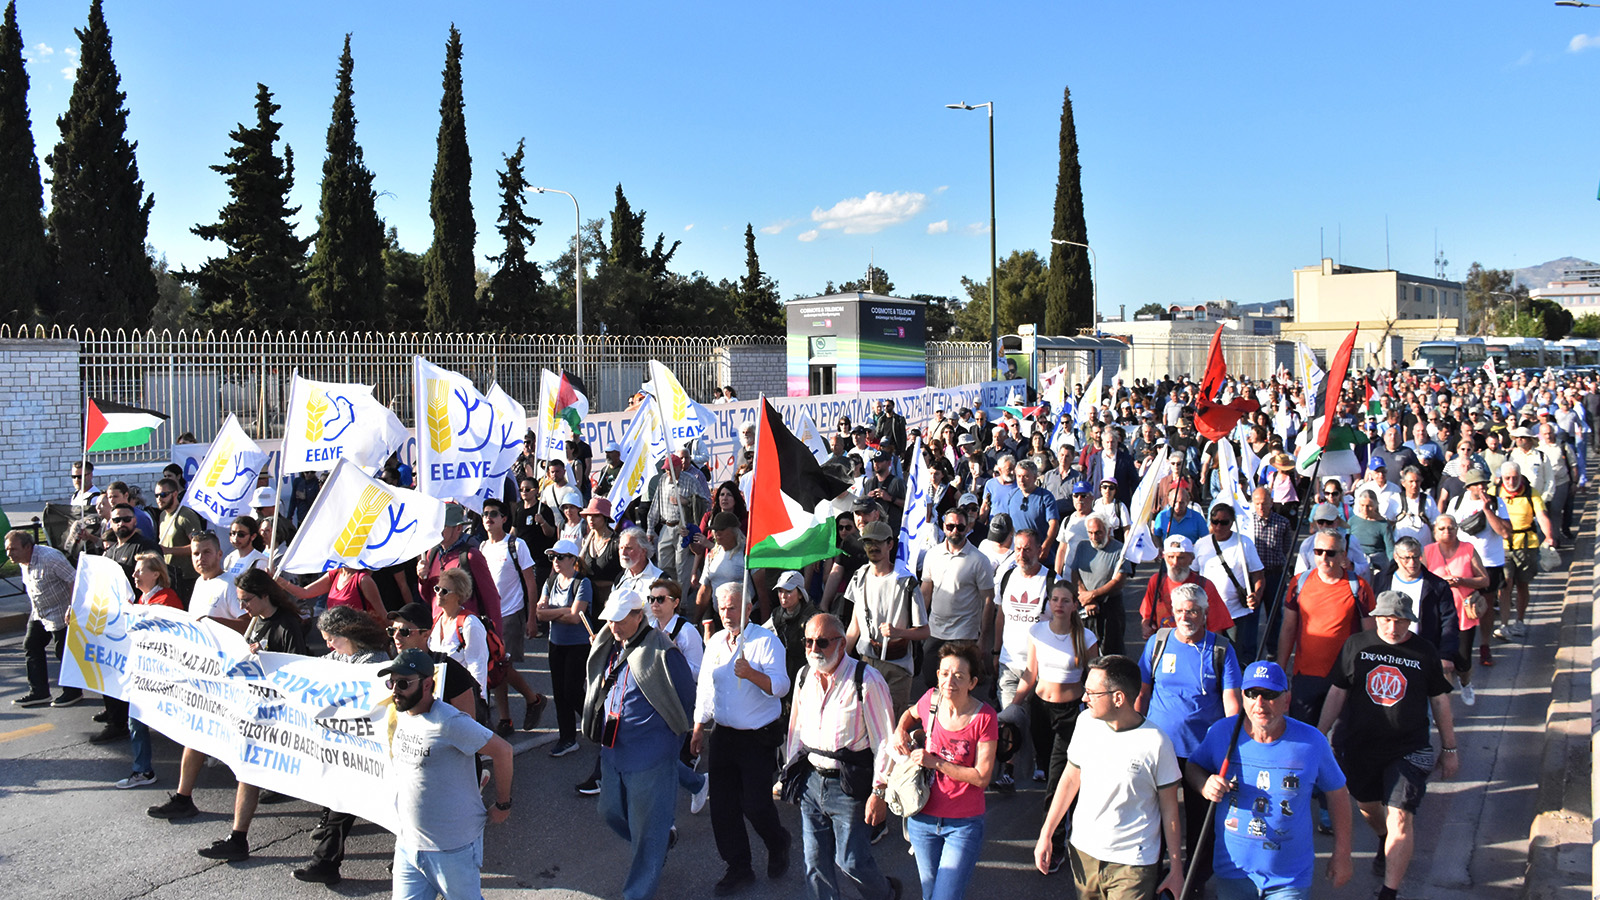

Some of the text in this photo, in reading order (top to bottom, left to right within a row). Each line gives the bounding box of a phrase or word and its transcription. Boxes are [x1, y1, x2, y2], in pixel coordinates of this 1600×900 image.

[871, 307, 892, 315] COSMOTE
[896, 308, 916, 316] TELEKOM
[305, 446, 343, 462] ΕΕΔΥΕ
[431, 461, 491, 481] ΕΕΔΥΕ
[194, 489, 239, 518] ΕΕΔΥΕ
[84, 643, 128, 675] ΕΕΔΥΕ
[198, 656, 220, 676] ΑΠΟ
[272, 669, 371, 711] ΕΙΡΗΝΗΣ
[280, 730, 292, 748] ΟΙ
[320, 747, 339, 766] ΤΟΥ
[342, 751, 385, 779] ΘΑΝΑΤΟΥ
